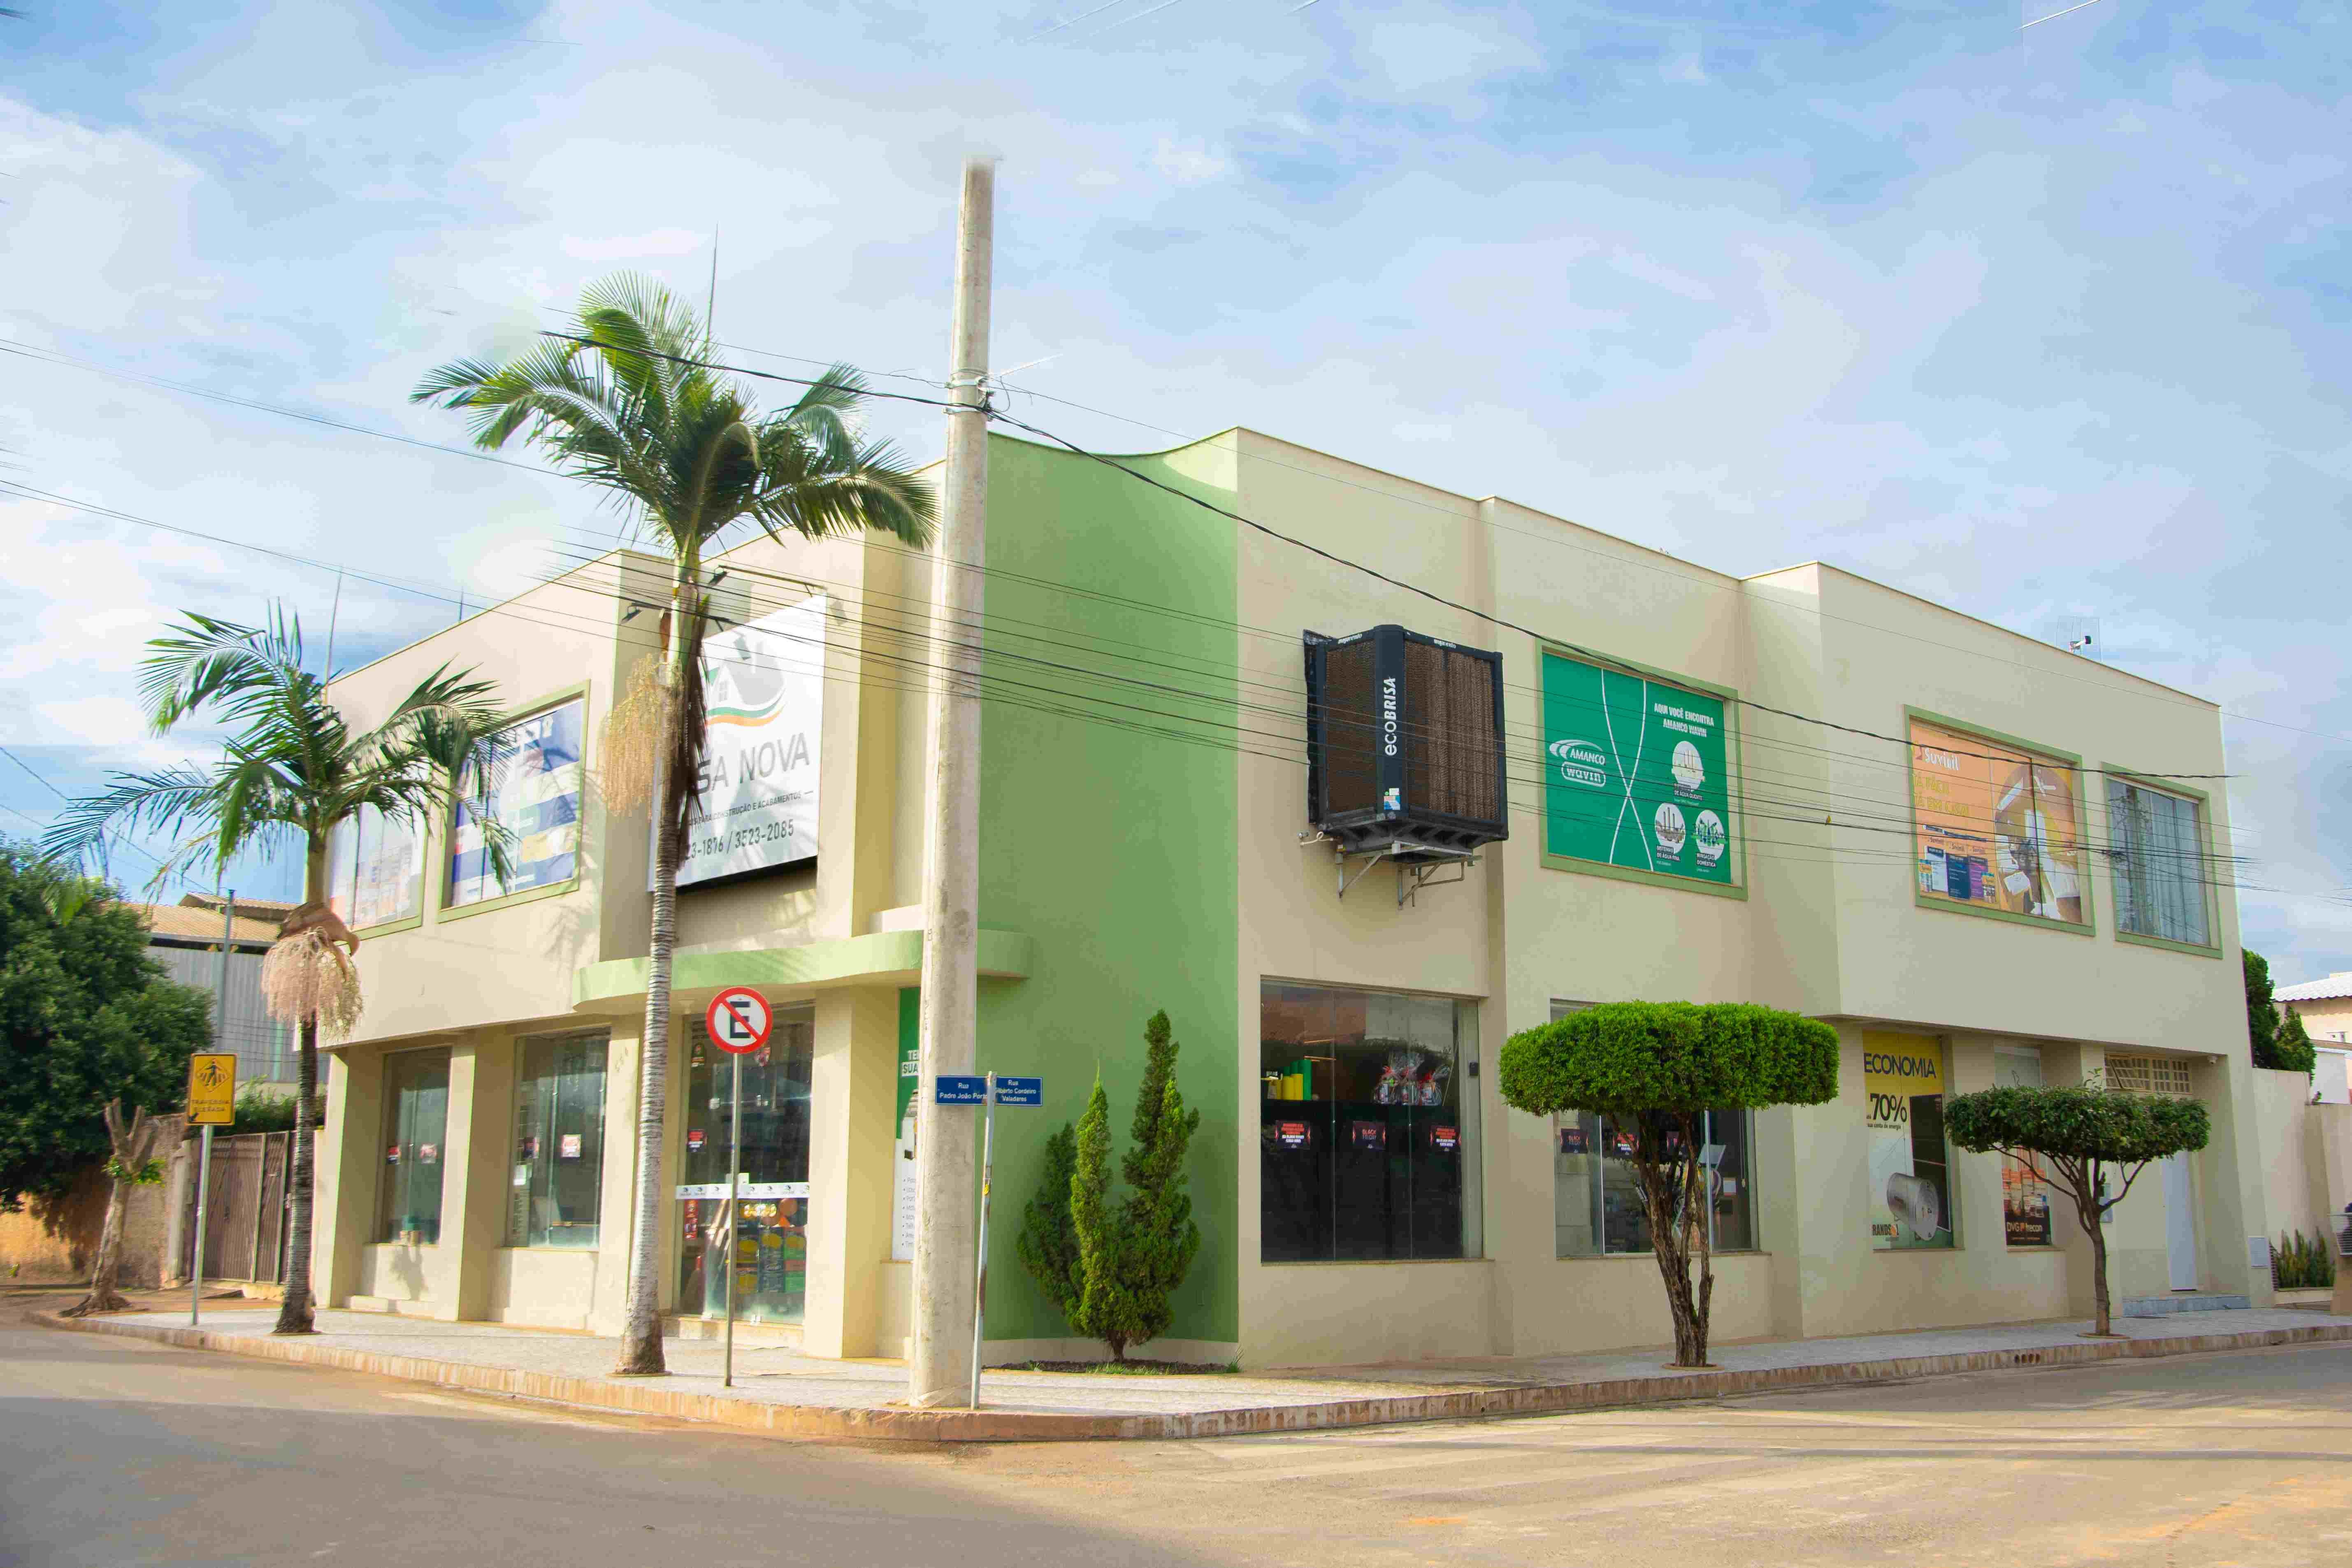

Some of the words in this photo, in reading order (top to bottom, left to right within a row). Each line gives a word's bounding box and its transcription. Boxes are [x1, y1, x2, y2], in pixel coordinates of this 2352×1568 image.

[1654, 703, 1668, 715] AQUI
[1669, 706, 1683, 718] VOCÊ
[1685, 711, 1714, 727] ENCONTRA
[1663, 718, 1688, 733] AMANCO
[1688, 725, 1707, 738] WAVIN
[740, 732, 810, 784] NOVA
[1570, 748, 1605, 765] AMANCO
[1925, 748, 1960, 771] Suvinil
[1566, 767, 1601, 782] wavin
[757, 791, 801, 809] ACABAMENTOS
[735, 819, 794, 848] 3523-2085
[730, 1001, 751, 1039] E
[1863, 1052, 1936, 1079] ECONOMIA
[1869, 1093, 1907, 1122] 70%
[2006, 1222, 2019, 1232] DVG
